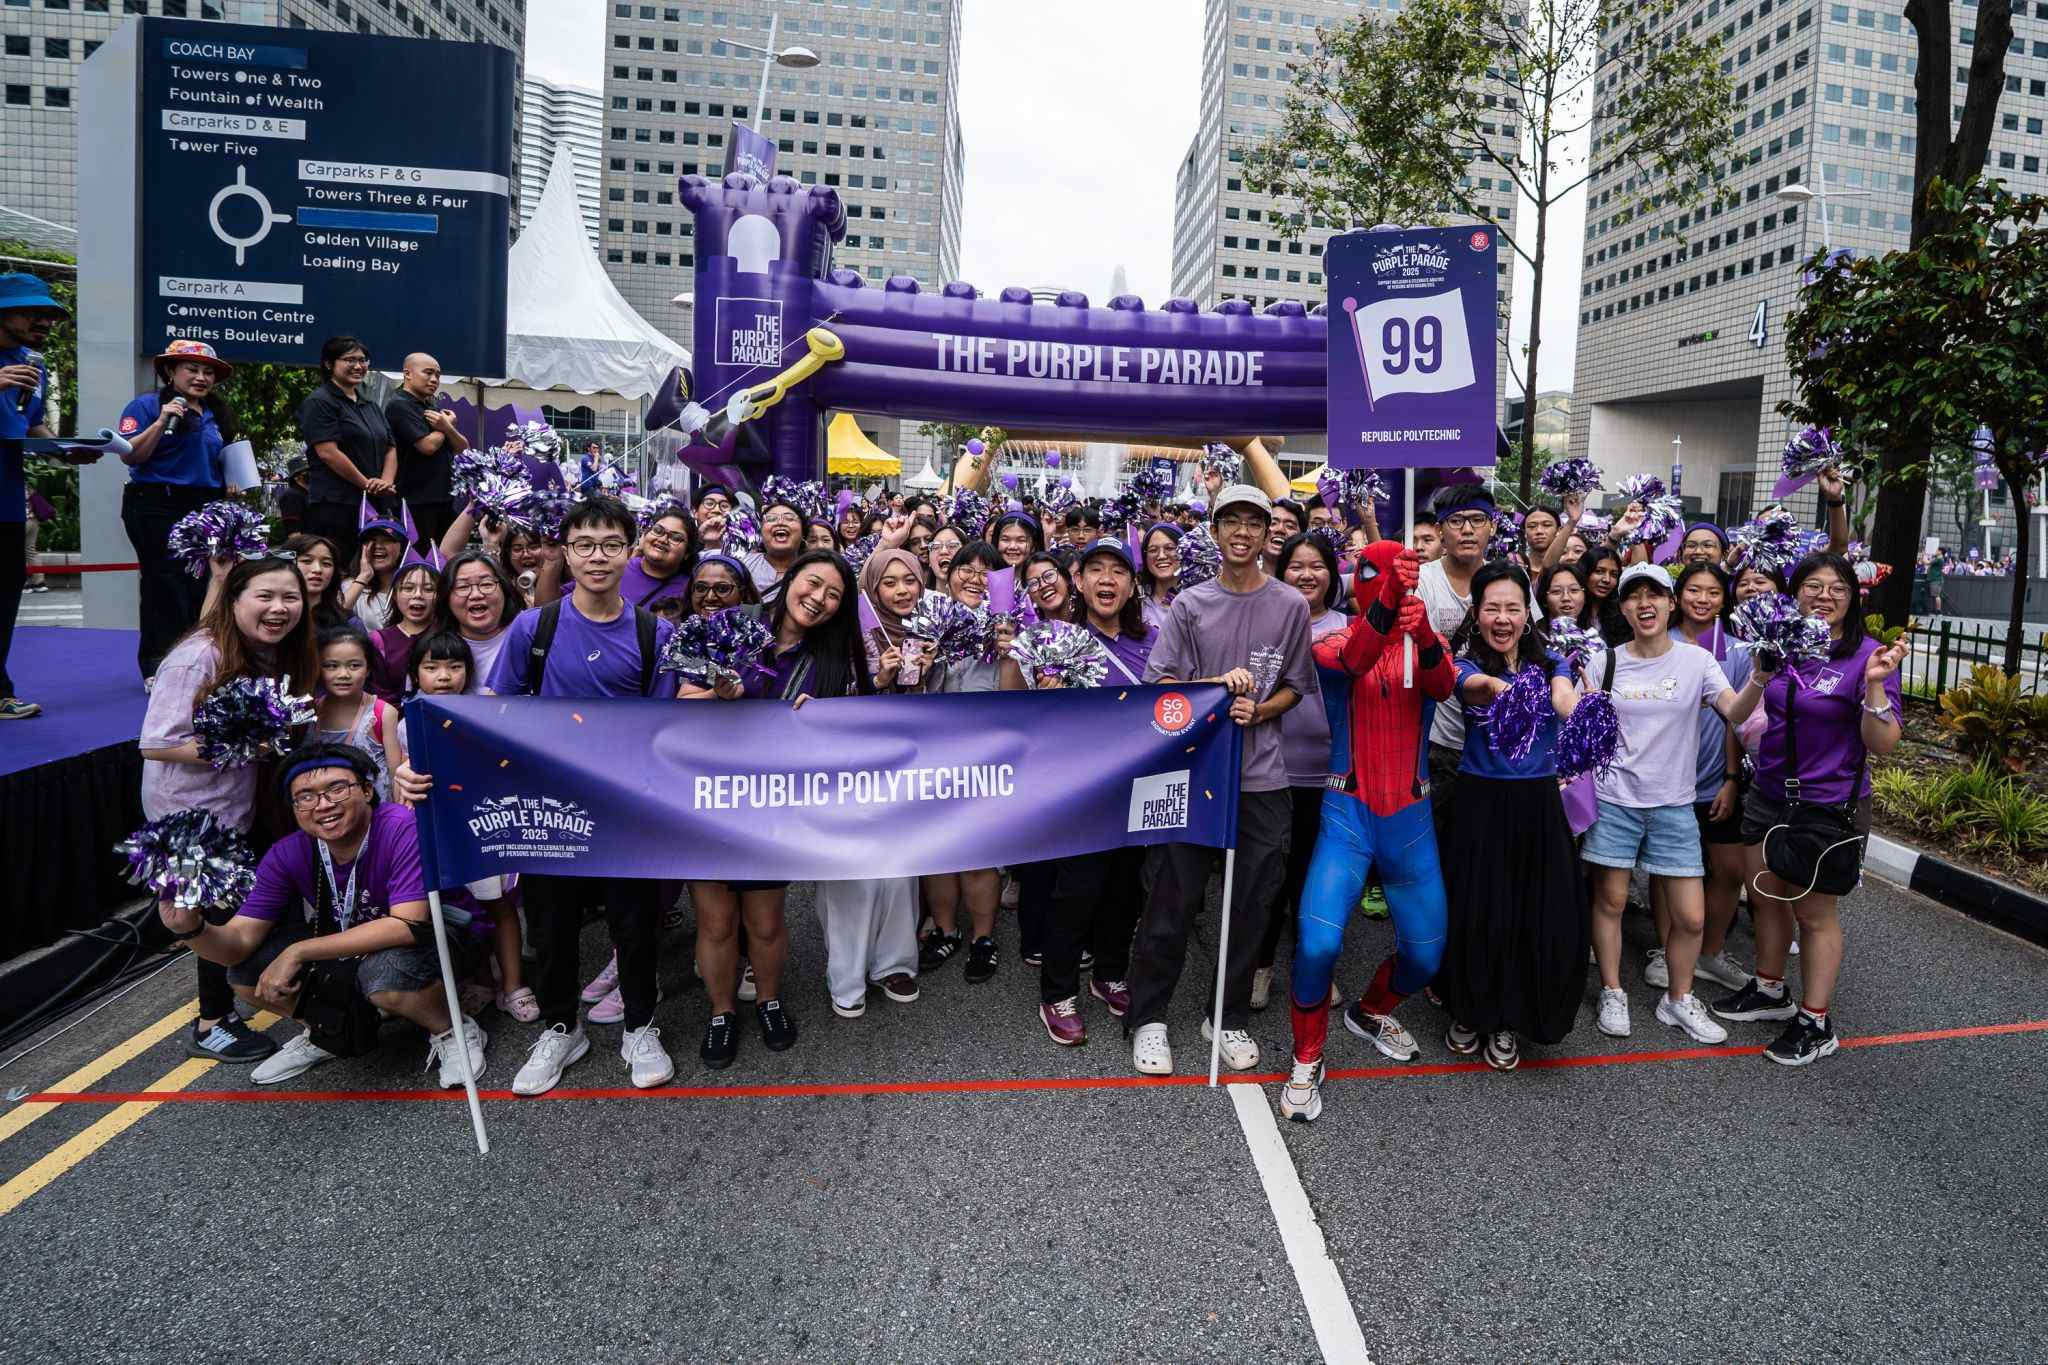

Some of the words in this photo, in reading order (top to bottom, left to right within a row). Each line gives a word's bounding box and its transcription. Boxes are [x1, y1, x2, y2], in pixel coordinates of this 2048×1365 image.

[169, 42, 223, 58] COACH
[227, 46, 255, 60] BAY
[170, 66, 230, 82] Towers
[235, 71, 267, 85] One
[272, 73, 283, 86] &
[288, 74, 322, 89] Two
[170, 88, 240, 104] Fountain
[246, 93, 262, 105] of
[267, 95, 324, 111] Wealth
[169, 113, 240, 130] Carparks
[246, 118, 257, 131] D
[262, 119, 273, 132] &
[279, 121, 289, 133] E
[169, 138, 220, 153] Tower
[225, 142, 258, 156] Five
[305, 162, 375, 179] Carparks
[380, 168, 390, 179] F
[394, 168, 406, 181] &
[411, 169, 422, 182] G
[305, 186, 362, 201] Towers
[368, 190, 412, 205] Three
[417, 194, 427, 207] &
[432, 195, 468, 209] Four
[304, 232, 360, 247] Golden
[366, 235, 419, 252] Village
[1405, 245, 1417, 254] THE
[303, 254, 366, 272] Loading
[372, 258, 401, 274] Bay
[1372, 254, 1409, 274] PURPLE
[1411, 253, 1451, 270] PARADE
[1402, 267, 1420, 276] 2025
[166, 279, 228, 294] Carpark
[234, 283, 245, 296] A
[167, 303, 257, 320] Convention
[262, 309, 315, 324] Centre
[754, 314, 779, 332] THE
[1748, 300, 1767, 348] 4
[166, 325, 220, 340] Raffles
[224, 328, 304, 344] Boulevard
[732, 330, 779, 348] PURPLE
[1382, 316, 1442, 375] 99
[732, 346, 779, 364] PARADE
[932, 332, 997, 374] THE
[1007, 339, 1130, 383] PURPLE
[1139, 347, 1264, 386] PARADE
[1361, 430, 1402, 442] REPUBLIC
[1404, 429, 1461, 442] POLYTECHNIC
[1162, 699, 1183, 710] SG
[1163, 710, 1184, 724] 60
[1150, 720, 1180, 736] SIGNATURE
[1180, 718, 1197, 734] EVENT
[694, 772, 829, 810] REPUBLIC
[838, 764, 1014, 804] POLYTECHNIC
[1166, 782, 1187, 798] THE
[522, 798, 540, 809] THE
[1143, 796, 1185, 814] PURPLE
[468, 810, 530, 837] PURPLE
[534, 810, 596, 837] PARADE
[1142, 811, 1185, 829] PARADE
[521, 828, 549, 840] 2025
[481, 844, 504, 854] SUPPORT
[498, 850, 506, 858] OF
